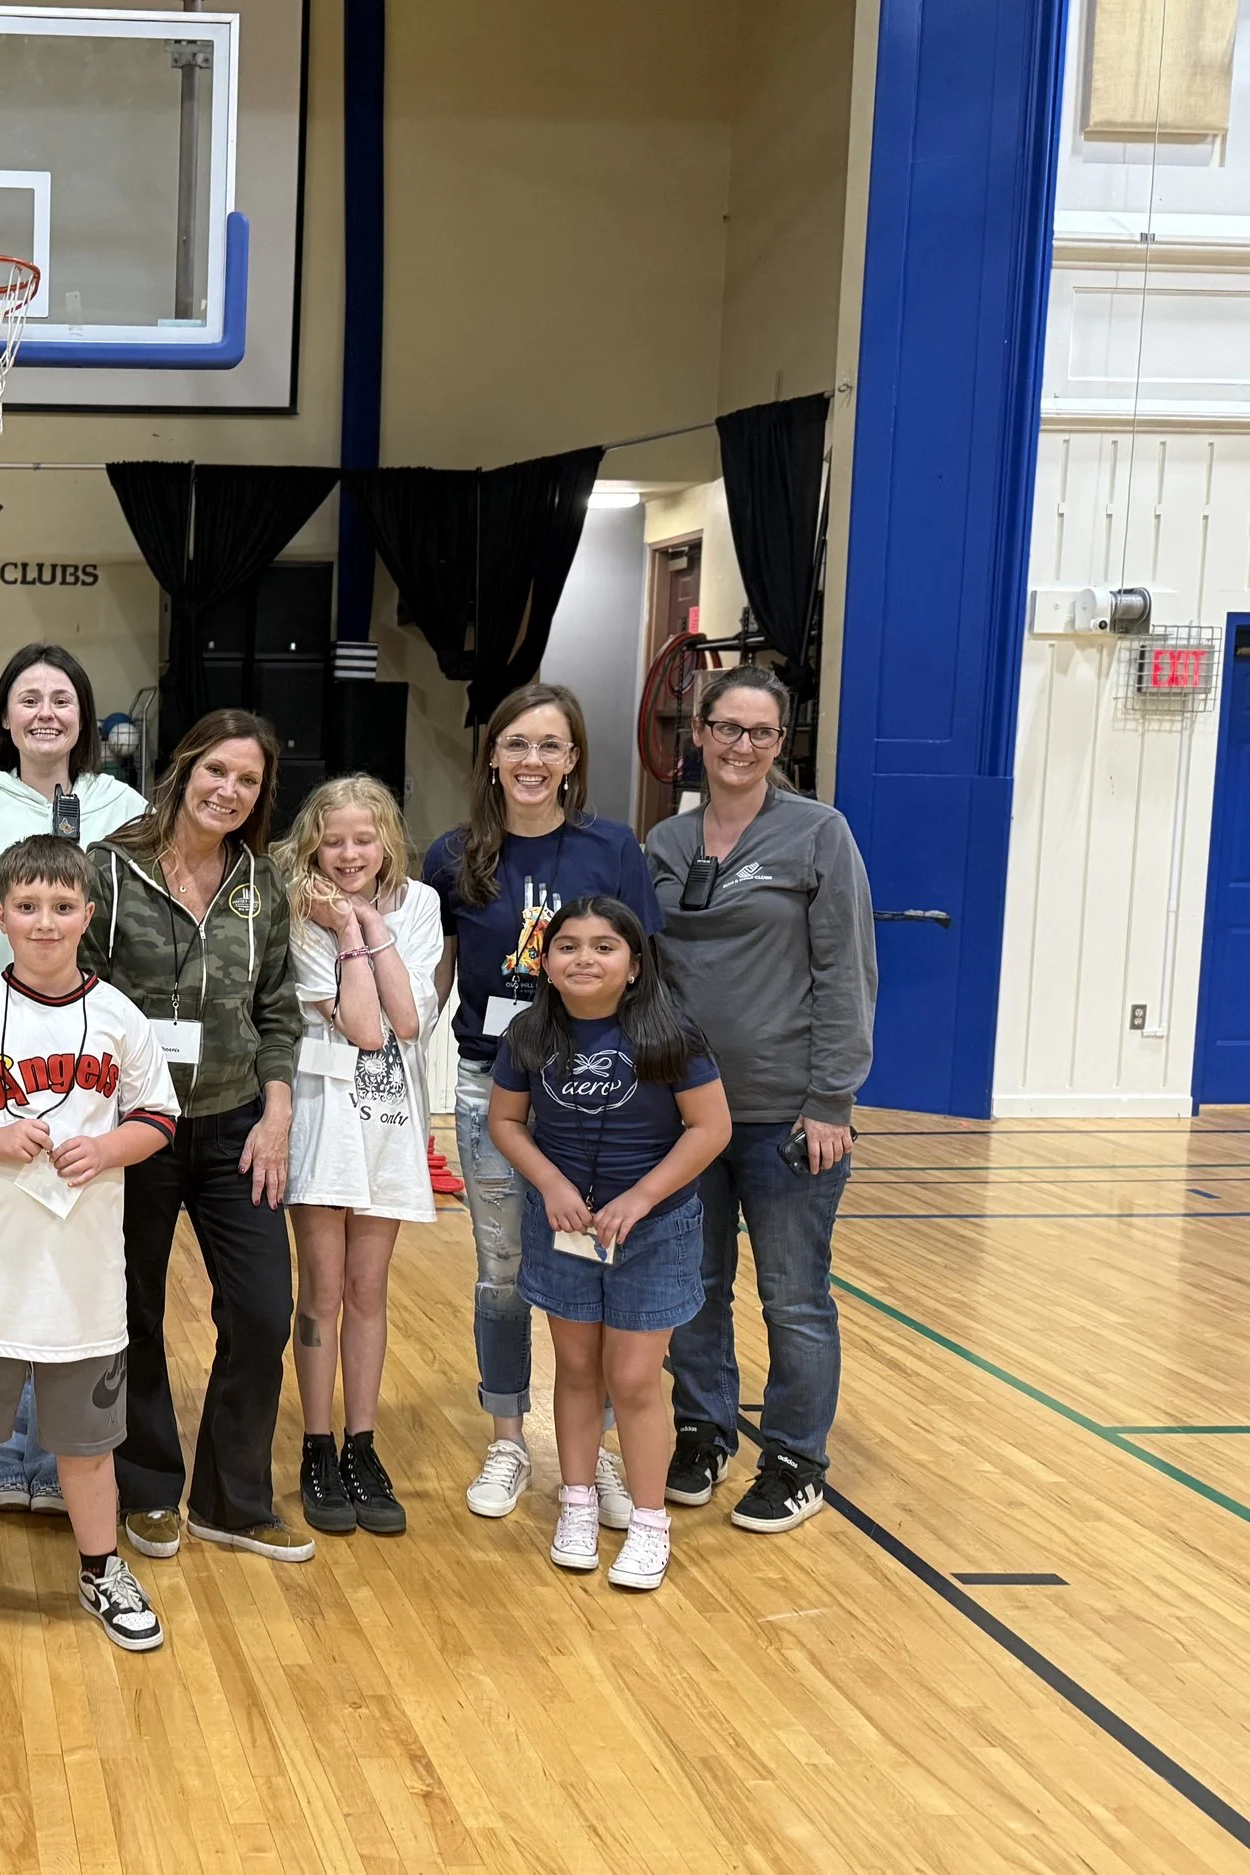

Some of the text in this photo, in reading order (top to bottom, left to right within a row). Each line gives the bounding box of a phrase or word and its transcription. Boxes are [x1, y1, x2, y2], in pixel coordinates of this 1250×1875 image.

[0, 562, 100, 586] CLUBS
[1152, 649, 1207, 688] EXIT
[561, 1079, 622, 1096] aero
[380, 1111, 409, 1126] only
[777, 1454, 799, 1469] adidas
